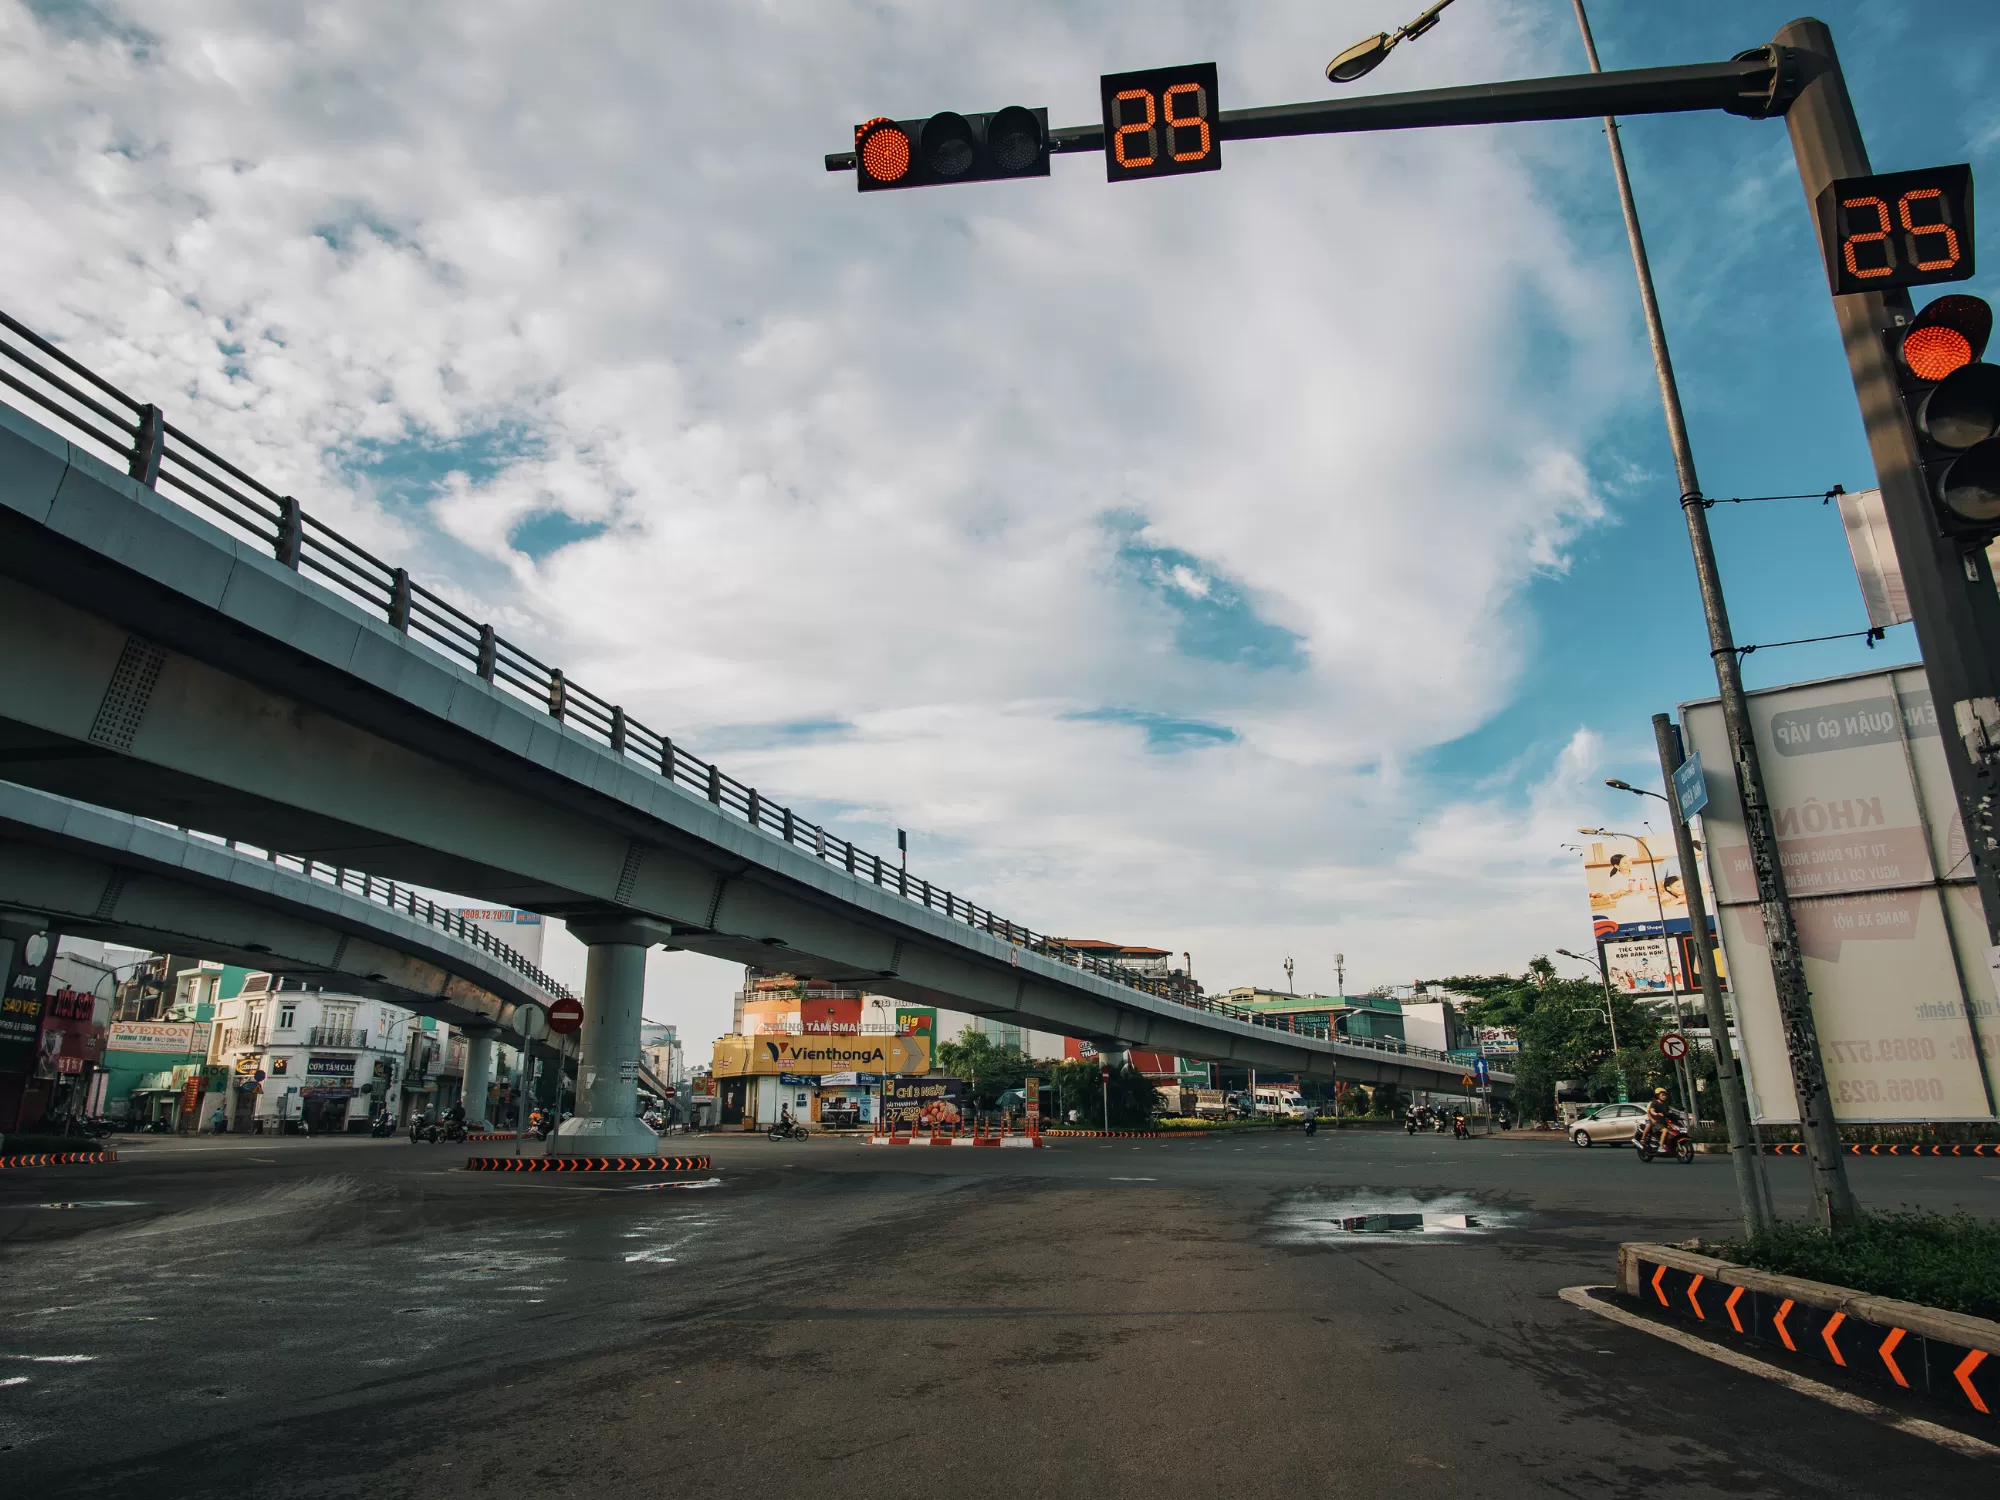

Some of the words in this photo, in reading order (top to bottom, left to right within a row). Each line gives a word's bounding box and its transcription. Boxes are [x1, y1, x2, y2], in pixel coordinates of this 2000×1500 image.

[1113, 82, 1211, 168] 25
[1842, 187, 1961, 280] 25
[2, 997, 21, 1011] SAO
[806, 1020, 831, 1032] TÂM
[832, 1023, 910, 1033] SMARTPHONE
[899, 1015, 918, 1027] Big
[112, 1023, 191, 1037] EVERON
[790, 1047, 885, 1063] VienthongA
[913, 1086, 921, 1097] 3
